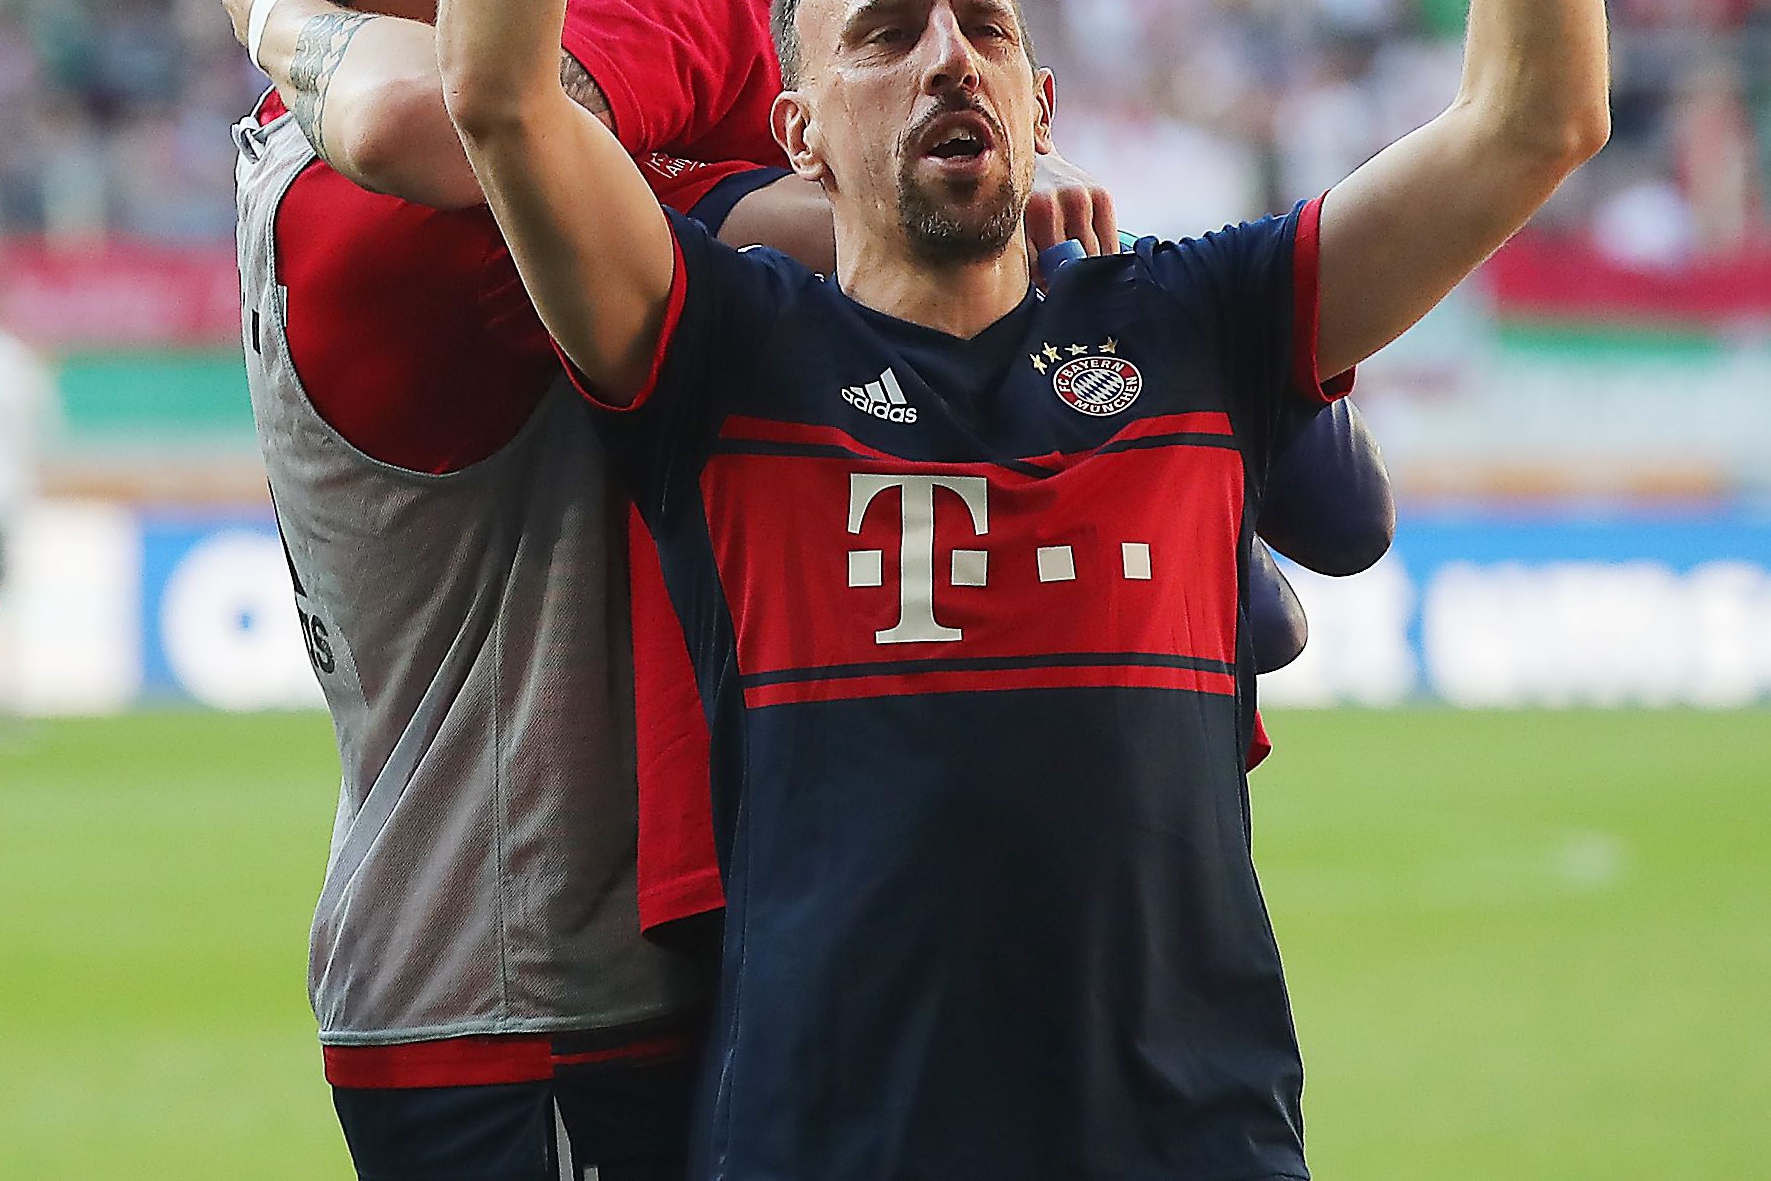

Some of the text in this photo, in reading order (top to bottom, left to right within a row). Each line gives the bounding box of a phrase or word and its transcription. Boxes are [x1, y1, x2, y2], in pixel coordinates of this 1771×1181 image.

[1057, 359, 1125, 393] FC BAYERN
[841, 387, 918, 423] adidas
[1073, 376, 1138, 413] MÜNCHEN
